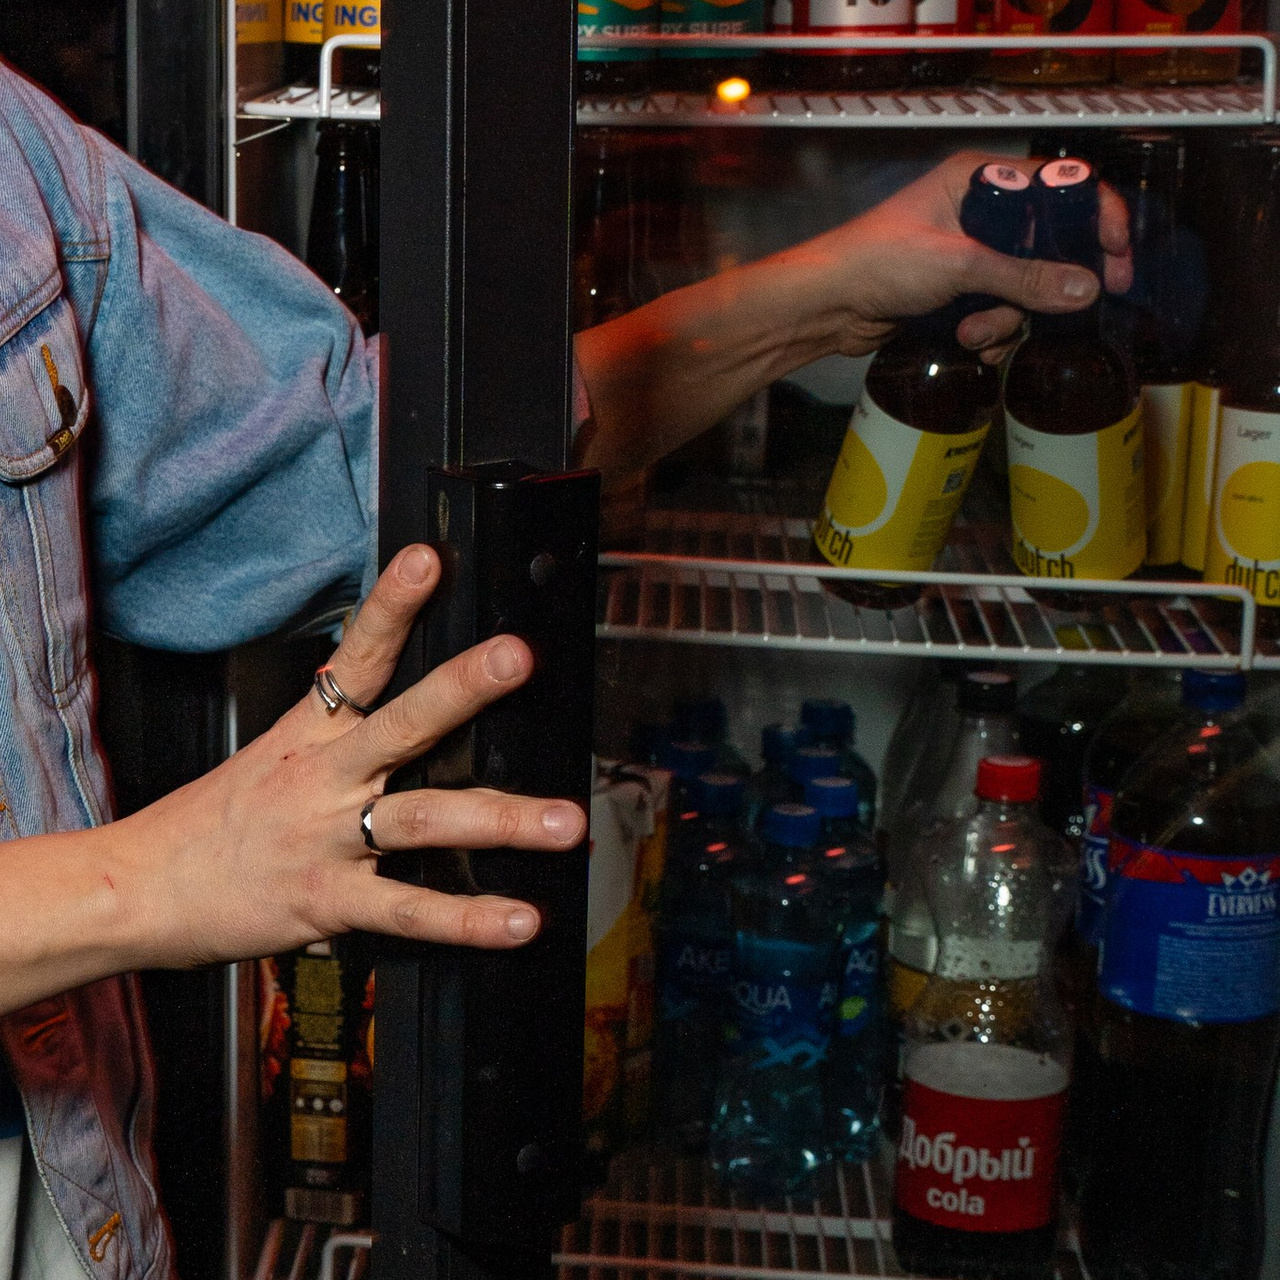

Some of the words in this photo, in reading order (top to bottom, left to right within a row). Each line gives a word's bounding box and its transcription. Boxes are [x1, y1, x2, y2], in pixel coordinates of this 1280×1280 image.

[1237, 425, 1272, 443] Lager
[1225, 556, 1280, 600] dutc
[900, 1115, 1035, 1184] Добрый
[926, 1187, 985, 1216] cola
